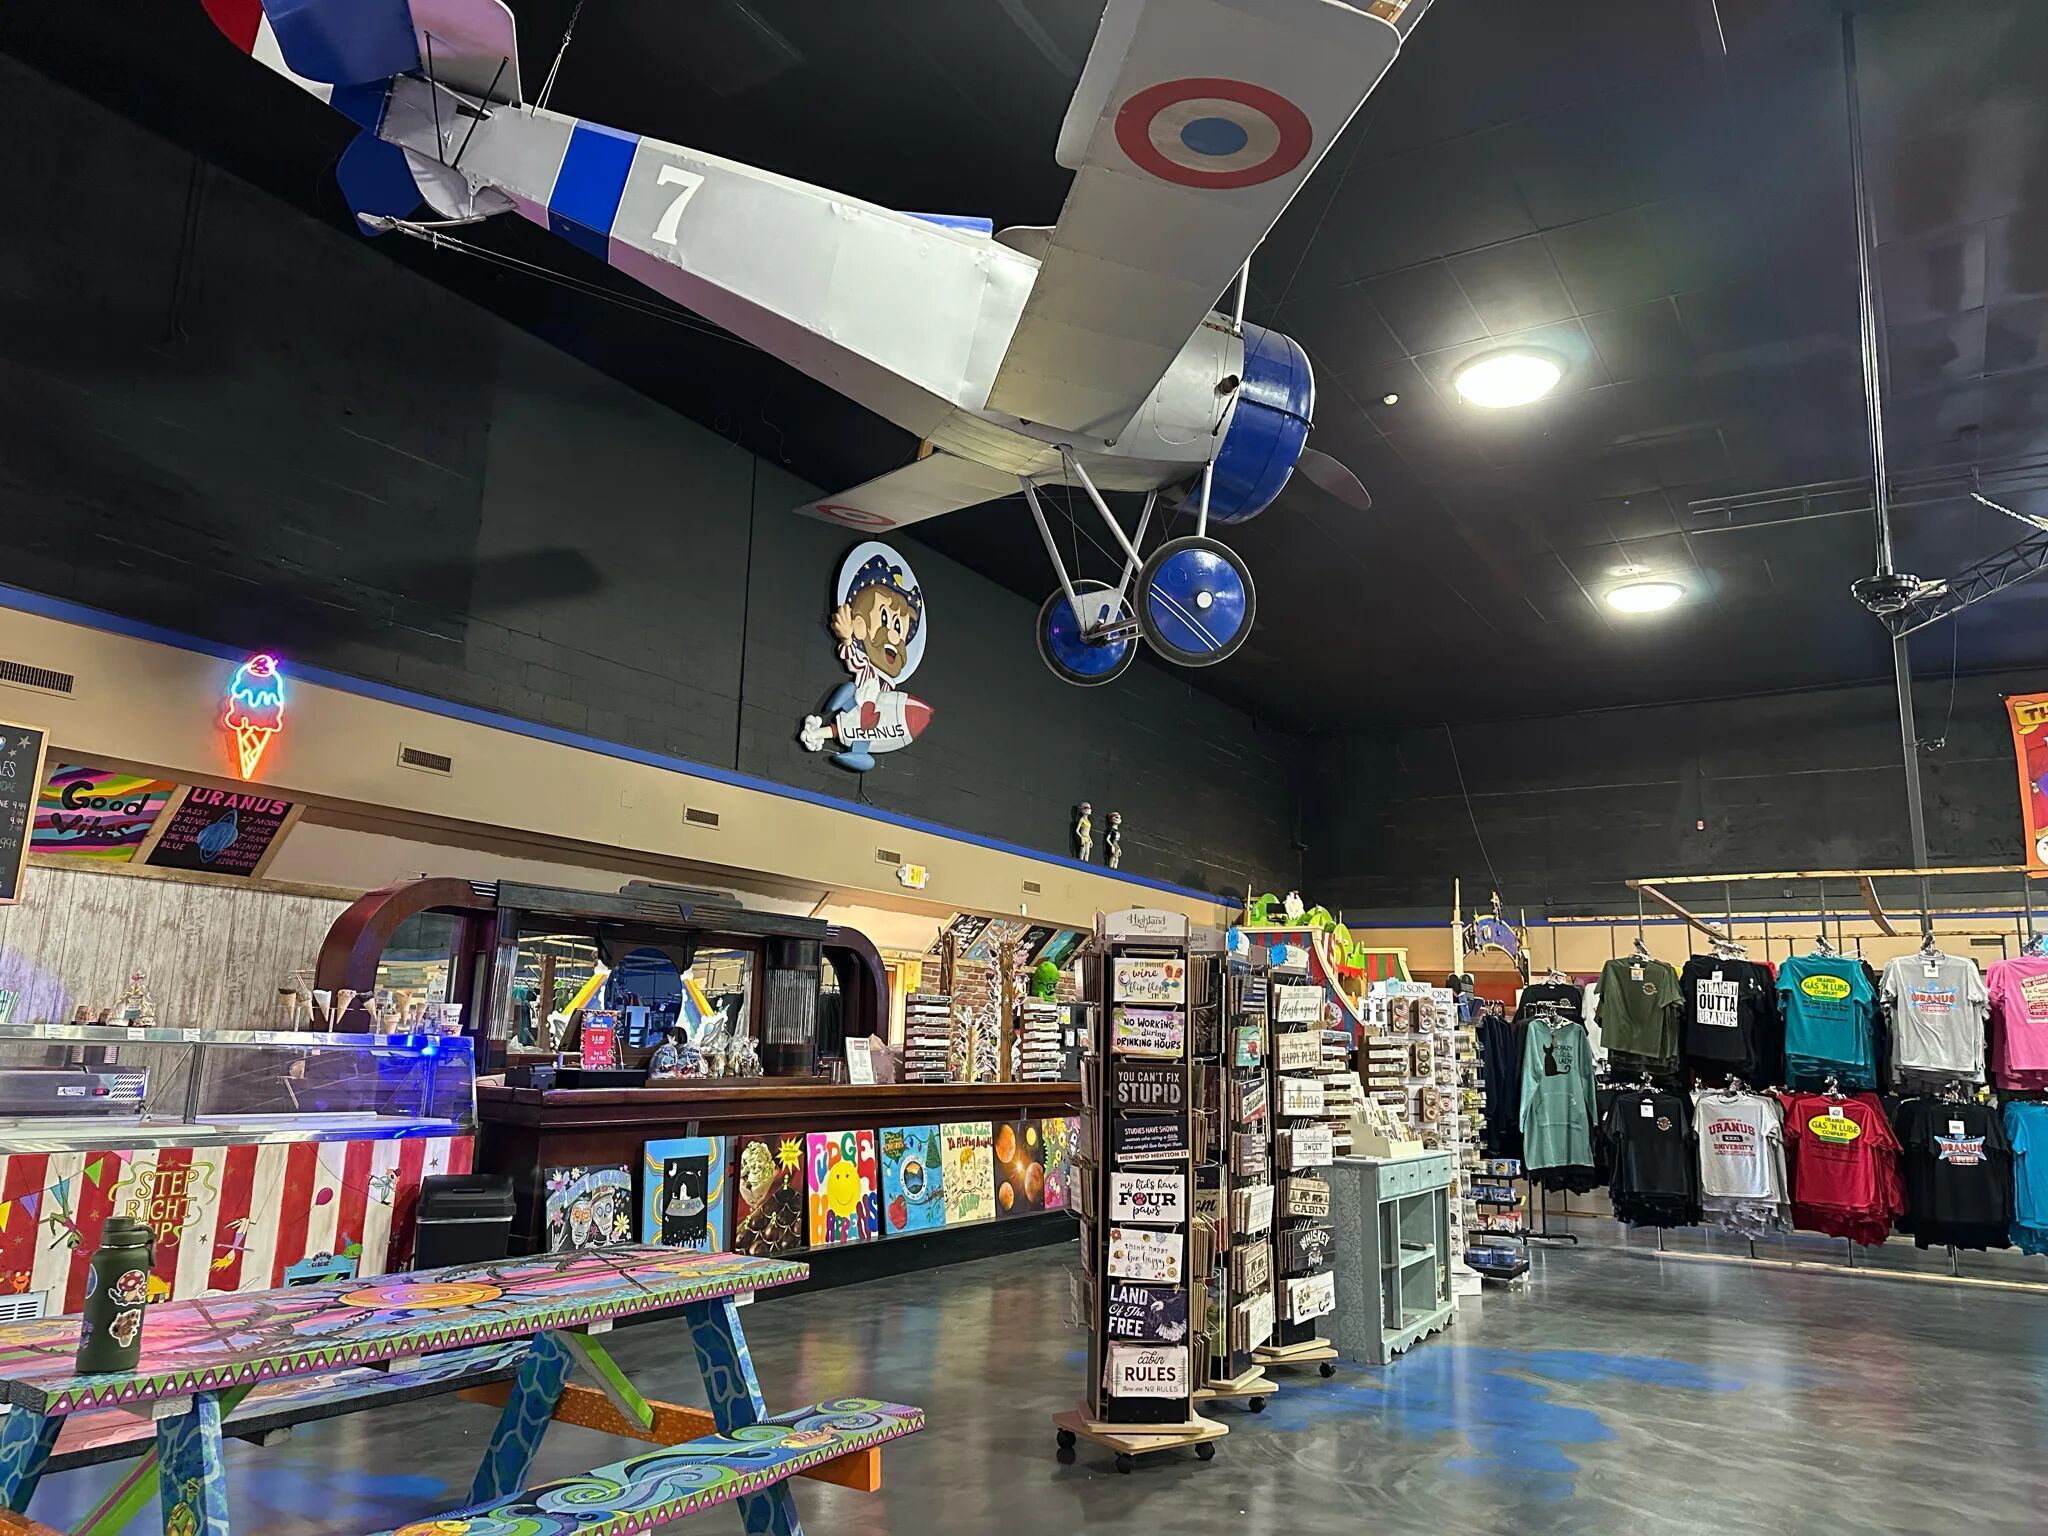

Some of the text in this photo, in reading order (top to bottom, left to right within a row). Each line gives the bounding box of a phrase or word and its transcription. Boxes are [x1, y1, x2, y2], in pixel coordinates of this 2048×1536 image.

[652, 164, 705, 246] 7
[844, 724, 904, 739] URANUS
[61, 780, 151, 816] Good
[191, 788, 287, 815] URANUS
[179, 807, 209, 816] GASSY
[50, 813, 131, 842] Vibes
[182, 816, 210, 826] RINGS
[171, 824, 198, 834] COLD
[245, 826, 272, 835] HUGE
[160, 841, 186, 851] BLUE
[232, 843, 264, 851] WINDY
[1127, 914, 1167, 929] Highland
[1132, 970, 1159, 978] wine
[1129, 982, 1169, 995] flip flops
[1698, 981, 1738, 996] STRAIGHT
[1803, 982, 1819, 990] GAS
[1830, 984, 1849, 993] LUBE
[1699, 994, 1736, 1013] OUTTA
[1911, 993, 1956, 1003] URANUS
[1124, 1018, 1135, 1026] NO
[1698, 1010, 1737, 1026] URANUS
[1141, 1029, 1167, 1041] during
[1116, 1037, 1181, 1050] DRINKING HOURS
[1118, 1071, 1180, 1083] YOU CAN'T FIX
[1118, 1082, 1181, 1104] STUPID
[1124, 1125, 1179, 1135] STUDIES HAVE SHOWN
[1708, 1122, 1756, 1136] URANUS
[1811, 1120, 1828, 1129] GAS
[1839, 1124, 1859, 1134] LUBE
[1303, 1142, 1322, 1151] SWEET
[1714, 1143, 1754, 1151] UNIVERSITY
[1942, 1143, 1983, 1152] URANUS
[808, 1131, 877, 1192] FUDGE
[135, 1170, 199, 1199] STEP
[1120, 1178, 1180, 1195] my kids have
[1118, 1192, 1177, 1206] FOUR
[125, 1197, 197, 1224] RIGHT
[1132, 1204, 1161, 1220] paws
[1293, 1204, 1326, 1214] CABIN
[811, 1192, 878, 1244] HAPPENS
[1124, 1243, 1145, 1251] think
[1299, 1229, 1331, 1252] WHISKEY
[1110, 1284, 1149, 1306] LAND
[1124, 1306, 1146, 1318] The
[1108, 1316, 1145, 1337] FREE
[1137, 1350, 1165, 1365] cabin
[1124, 1366, 1177, 1382] RULES
[1156, 1385, 1179, 1393] RULES
